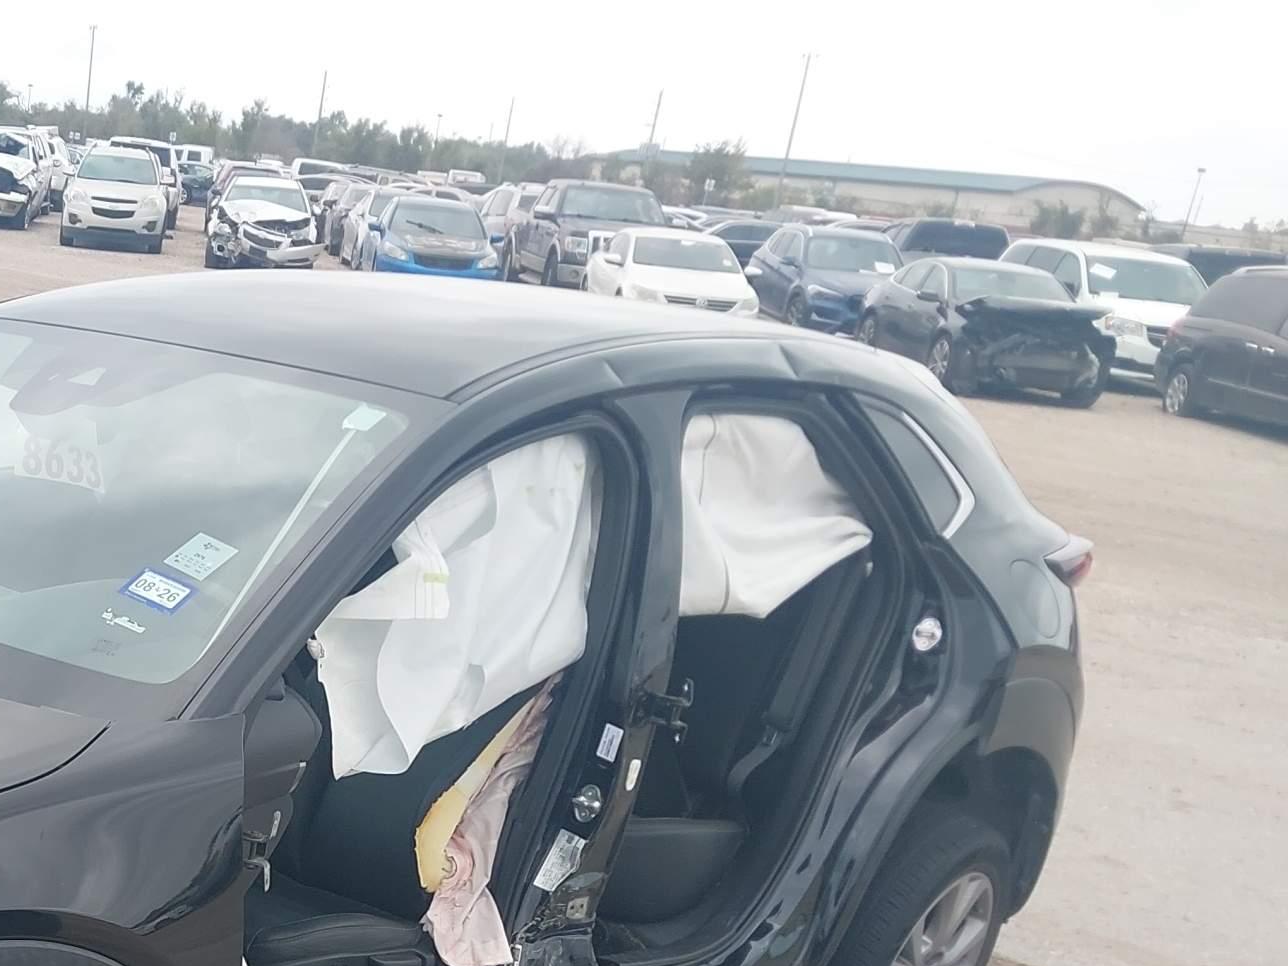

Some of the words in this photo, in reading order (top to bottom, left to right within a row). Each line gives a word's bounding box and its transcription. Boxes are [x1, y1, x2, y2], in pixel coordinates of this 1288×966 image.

[22, 435, 101, 489] 8633
[134, 578, 156, 592] 08
[157, 588, 180, 603] 26
